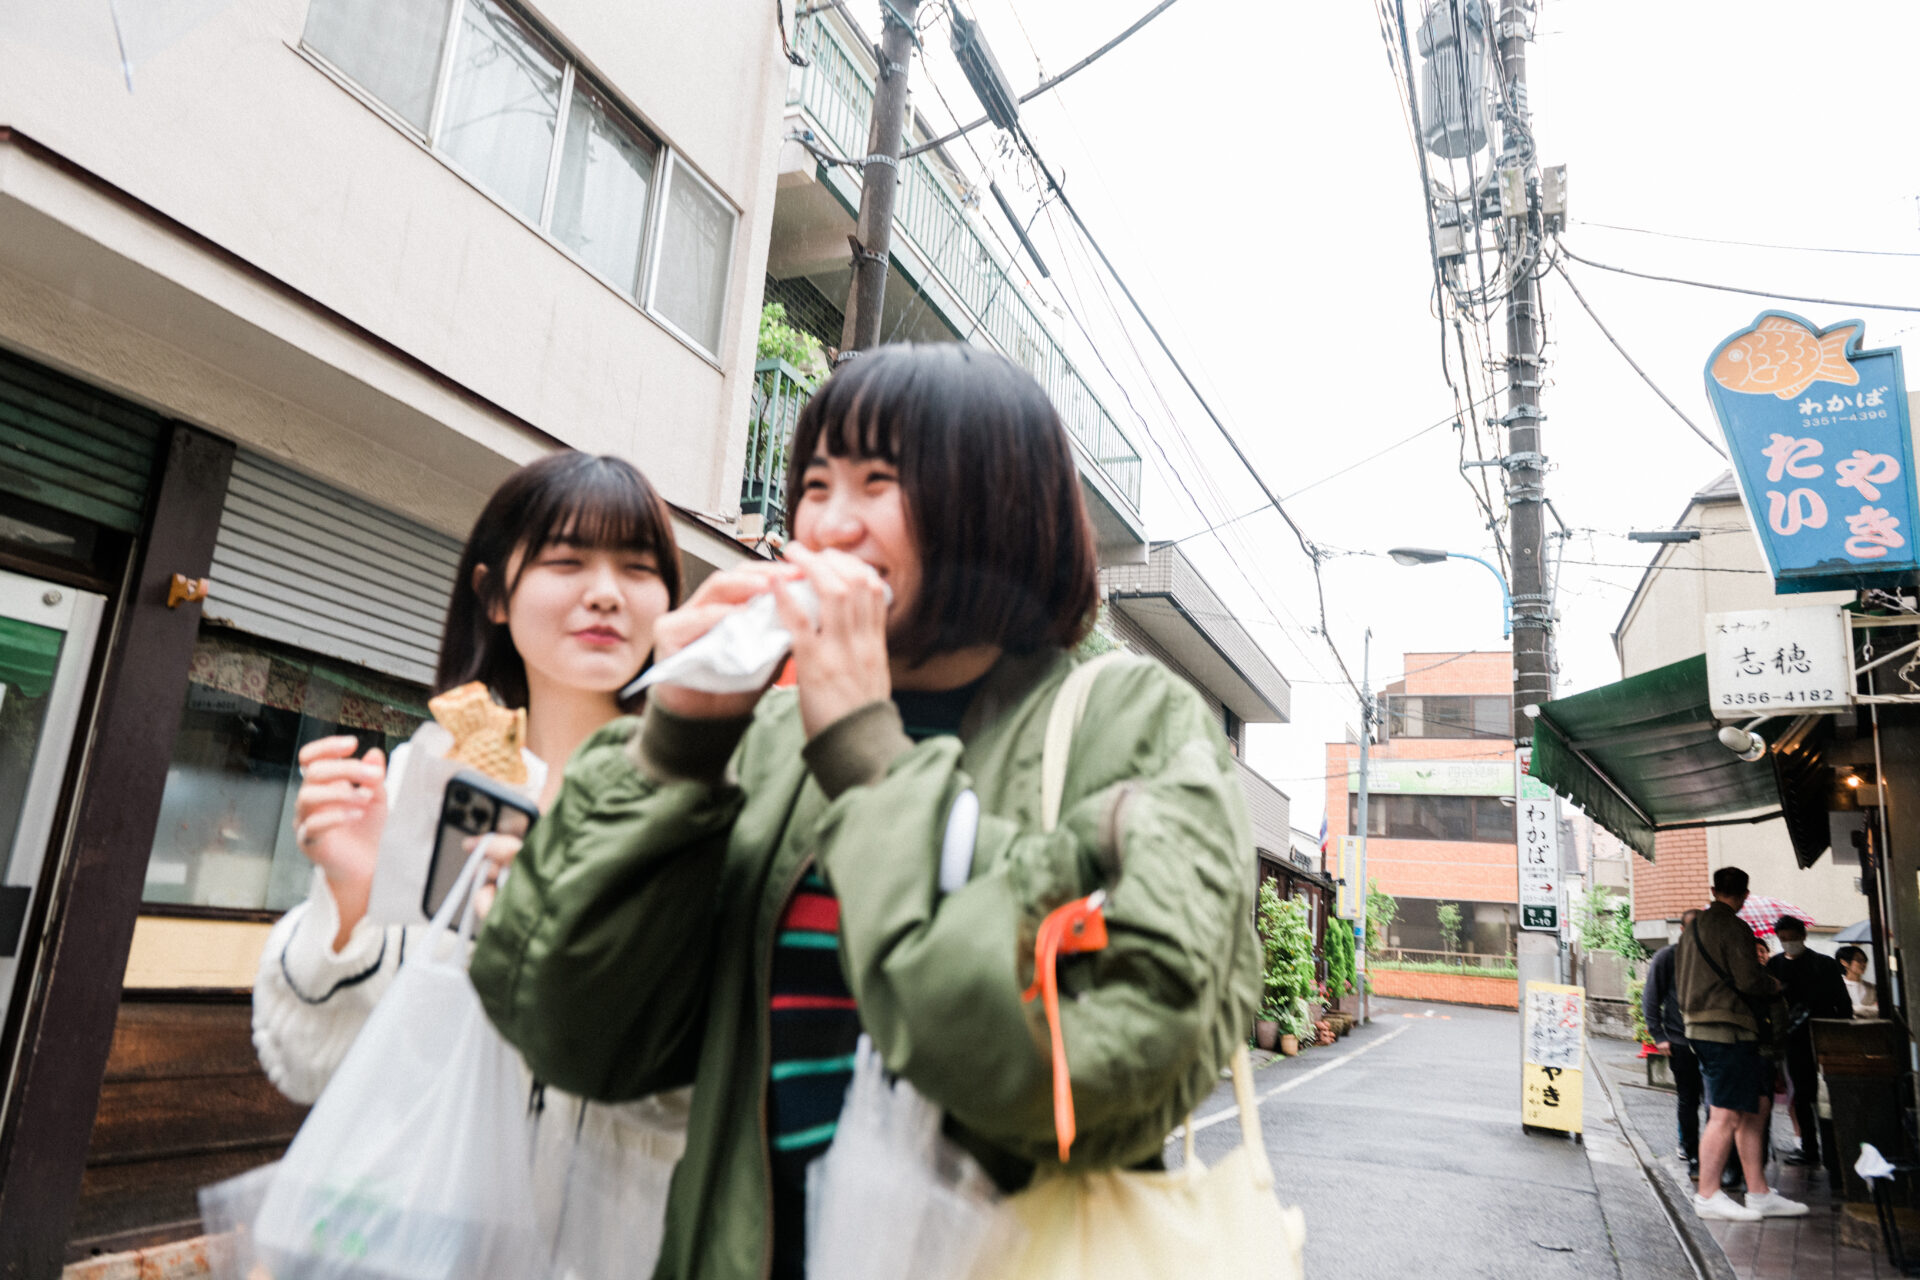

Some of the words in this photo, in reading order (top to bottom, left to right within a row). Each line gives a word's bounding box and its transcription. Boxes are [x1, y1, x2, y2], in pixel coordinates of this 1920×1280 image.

[1798, 386, 1888, 415] わかば
[1762, 433, 1828, 536] たい
[1835, 450, 1905, 558] やき
[1715, 620, 1770, 634] スナック
[1722, 689, 1834, 705] 3356-4182
[1526, 804, 1550, 865] わかば
